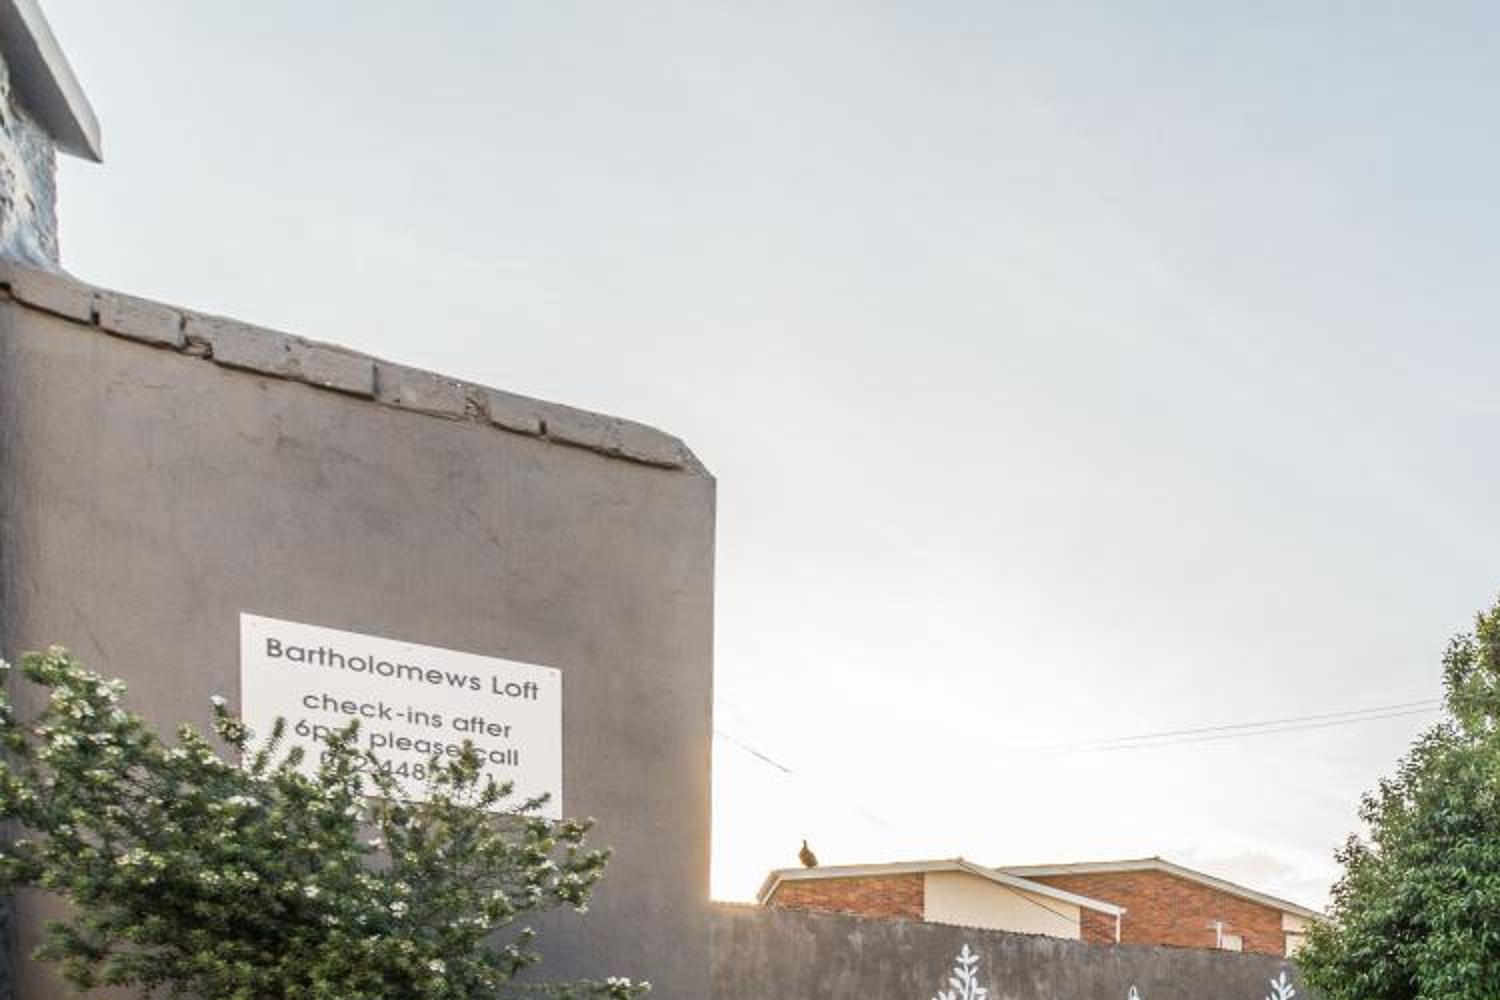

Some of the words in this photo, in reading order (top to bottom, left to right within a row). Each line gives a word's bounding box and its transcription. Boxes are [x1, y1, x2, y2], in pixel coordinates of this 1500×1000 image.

[266, 638, 481, 691] Bartholomews
[492, 675, 538, 701] Loft
[303, 692, 443, 729] check-ins
[452, 715, 511, 740] after
[369, 732, 461, 758] please
